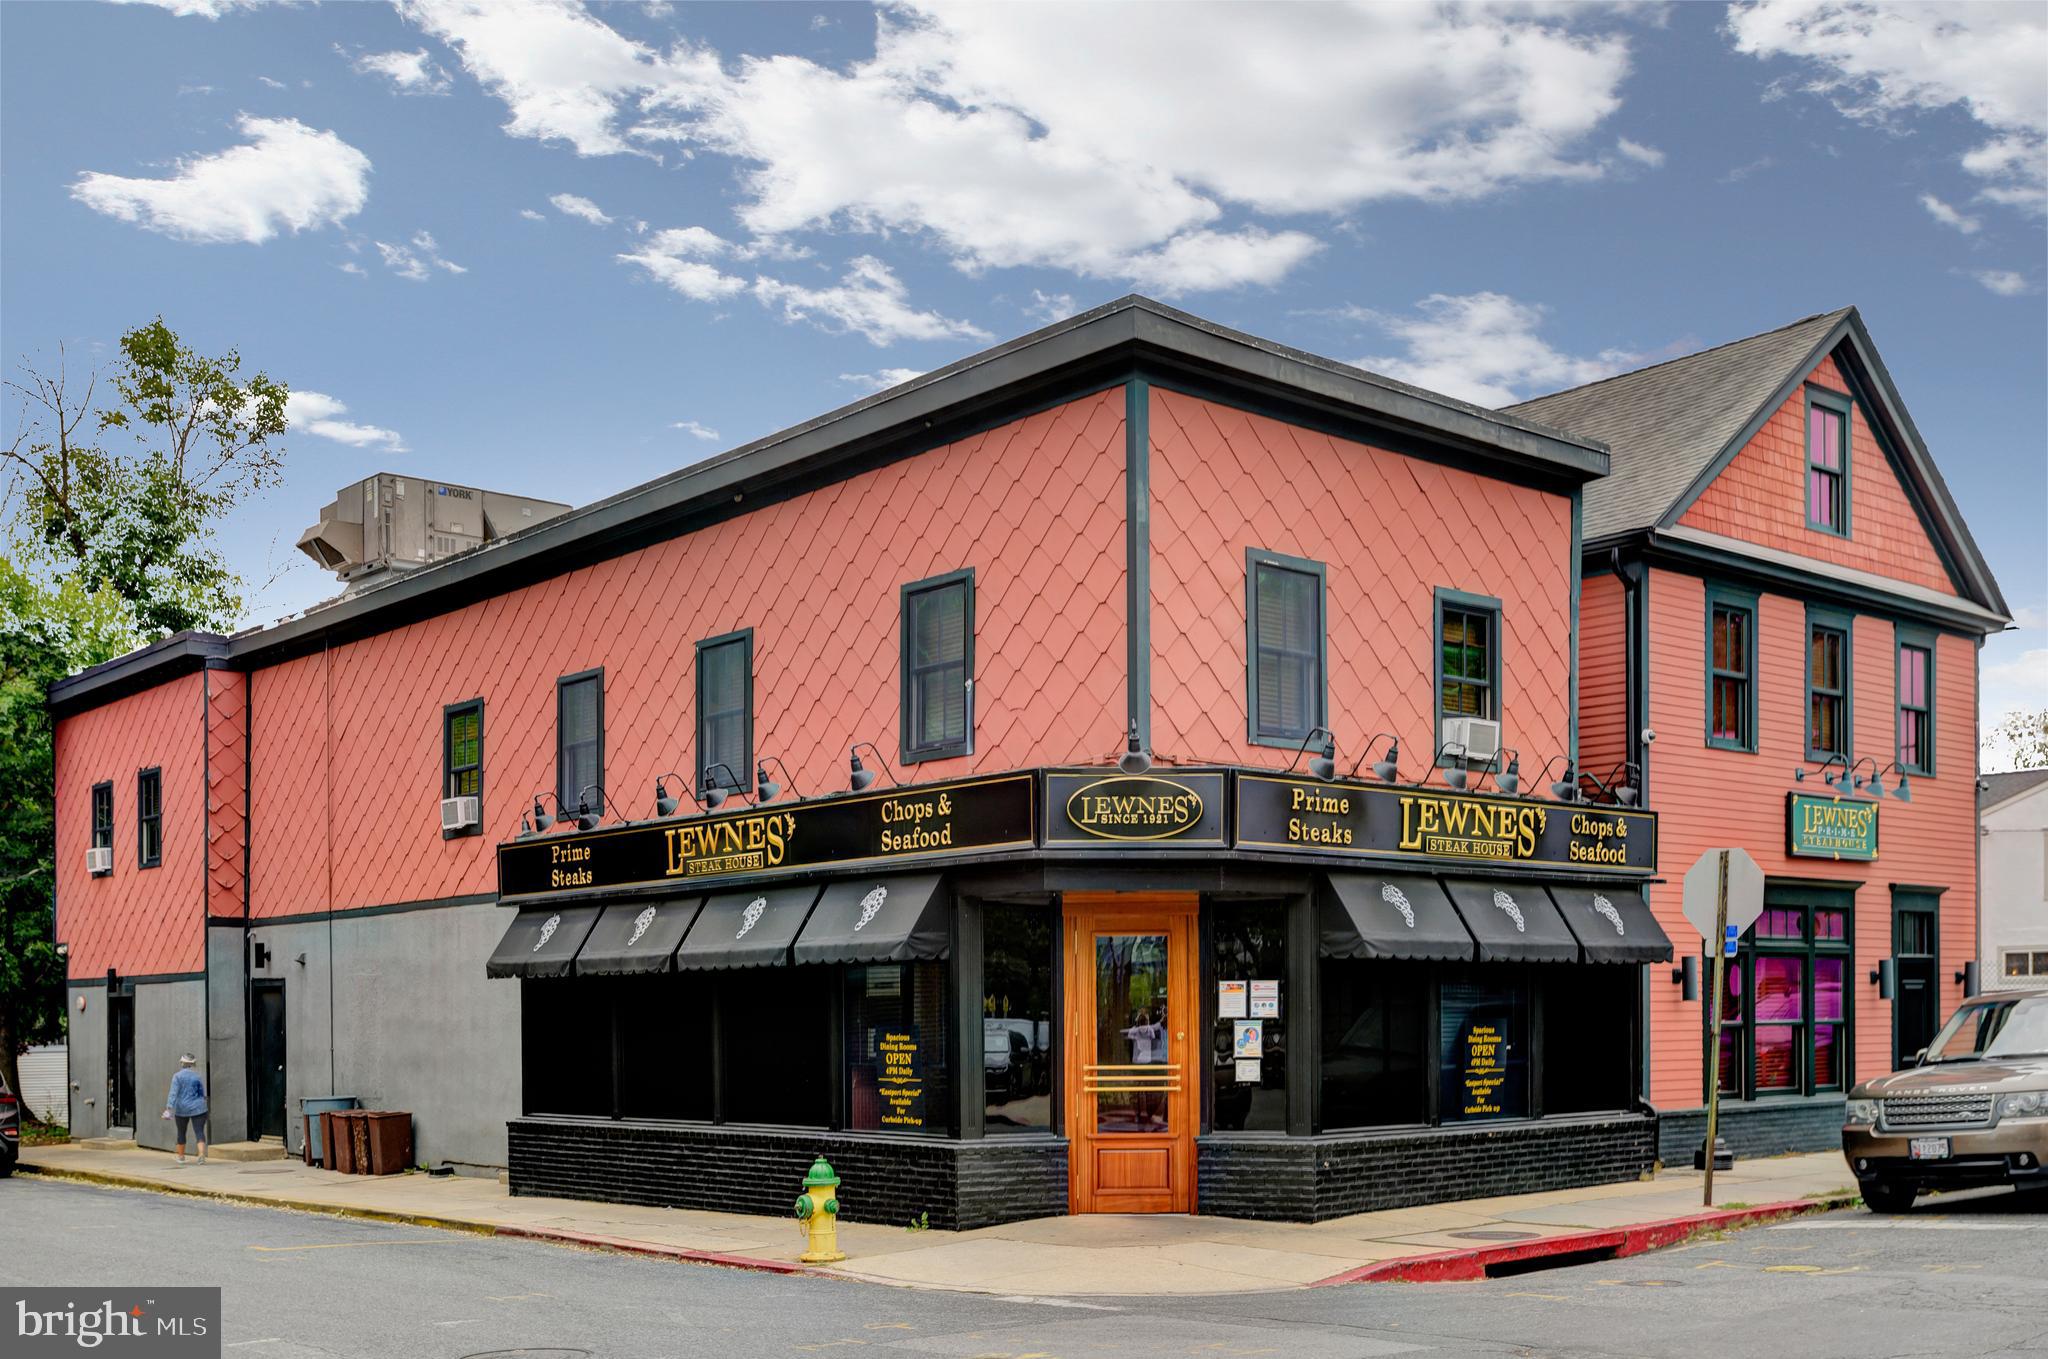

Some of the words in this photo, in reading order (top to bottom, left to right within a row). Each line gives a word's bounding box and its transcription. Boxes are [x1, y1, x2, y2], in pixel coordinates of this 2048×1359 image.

[447, 488, 472, 500] YORK
[881, 800, 933, 823] Chops
[938, 793, 952, 816] &
[1292, 788, 1349, 814] Prime
[1101, 814, 1138, 824] SINCE
[1143, 814, 1169, 824] 1921
[1571, 814, 1613, 839] Chops
[1616, 817, 1627, 837] &
[881, 823, 952, 851] Seafood
[1289, 818, 1352, 844] Steaks
[551, 845, 591, 864] Prime
[1430, 839, 1469, 853] STEAK
[1473, 842, 1511, 856] HOUSE
[1570, 840, 1626, 864] Seafood
[688, 860, 722, 875] STEAK
[725, 855, 760, 870] HOUSE
[551, 868, 593, 887] Steaks
[886, 1053, 912, 1065] OPEN
[1471, 1045, 1495, 1057] OPEN
